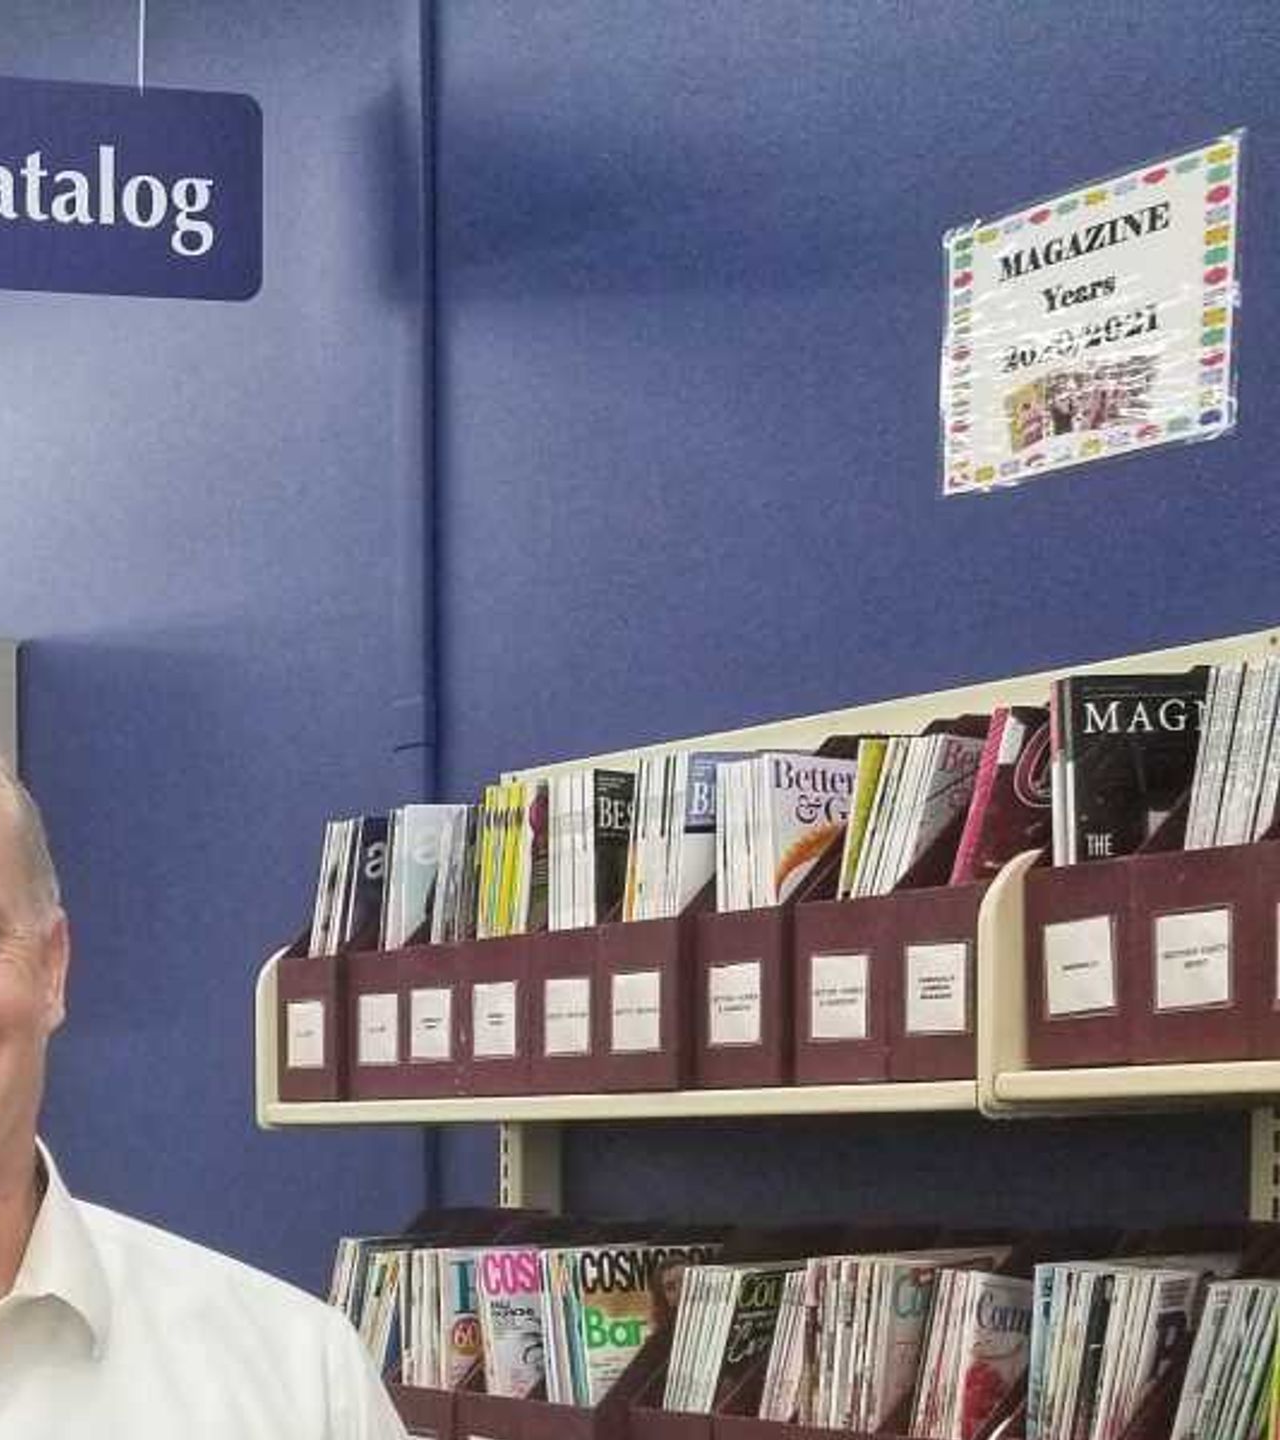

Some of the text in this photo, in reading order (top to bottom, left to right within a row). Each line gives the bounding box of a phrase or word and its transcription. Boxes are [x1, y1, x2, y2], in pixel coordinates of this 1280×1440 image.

[997, 200, 1172, 283] MAGAZINE
[1041, 274, 1117, 313] Years
[1087, 833, 1115, 857] THE
[484, 1252, 543, 1296] COS
[585, 1306, 647, 1349] Bar
